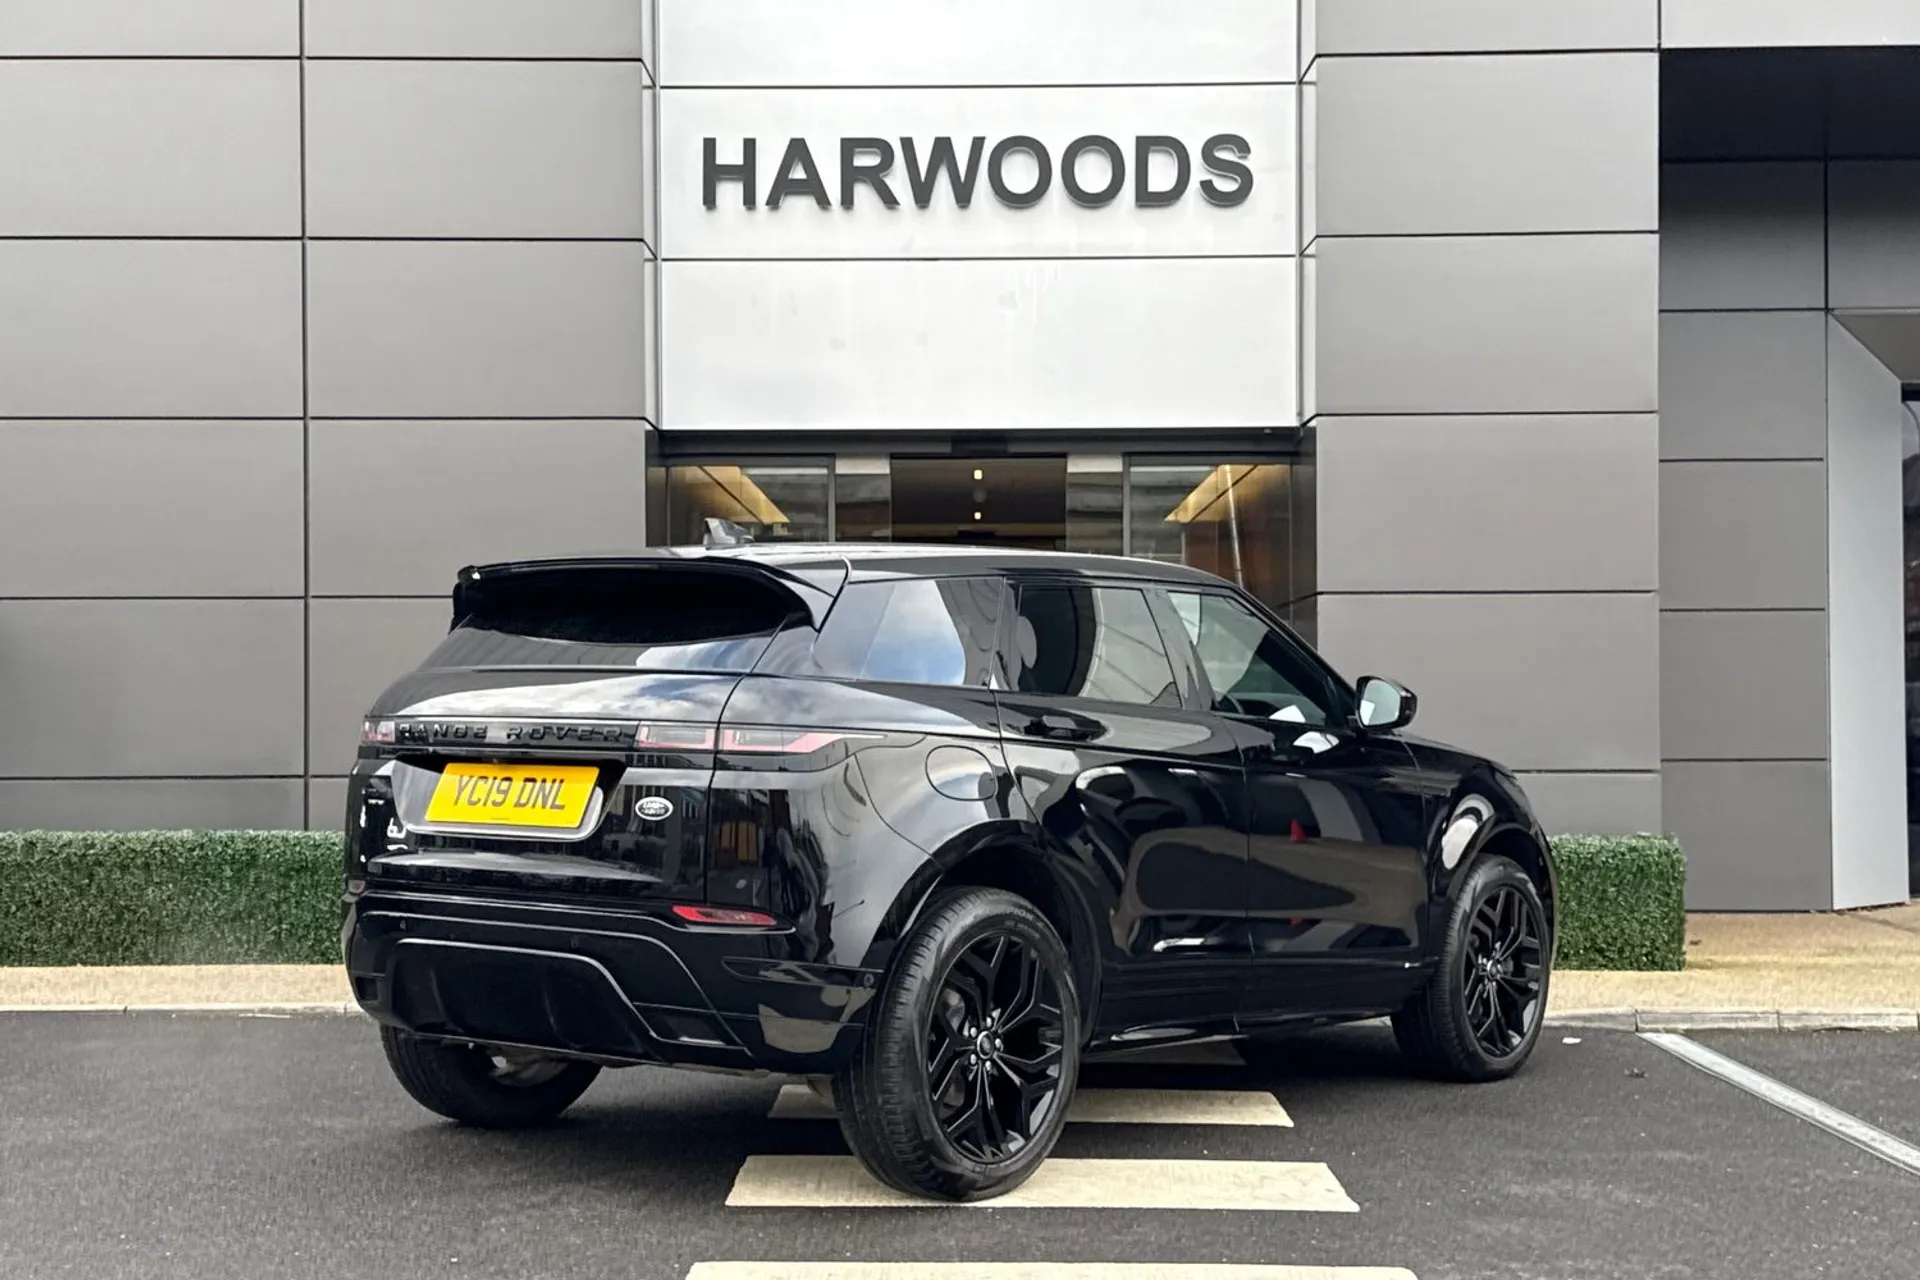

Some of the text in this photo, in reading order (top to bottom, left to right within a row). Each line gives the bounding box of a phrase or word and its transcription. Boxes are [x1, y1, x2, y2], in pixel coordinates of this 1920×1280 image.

[703, 134, 1255, 209] HARWOODS
[505, 725, 621, 742] ROVER
[453, 775, 566, 810] YC19 DNL
